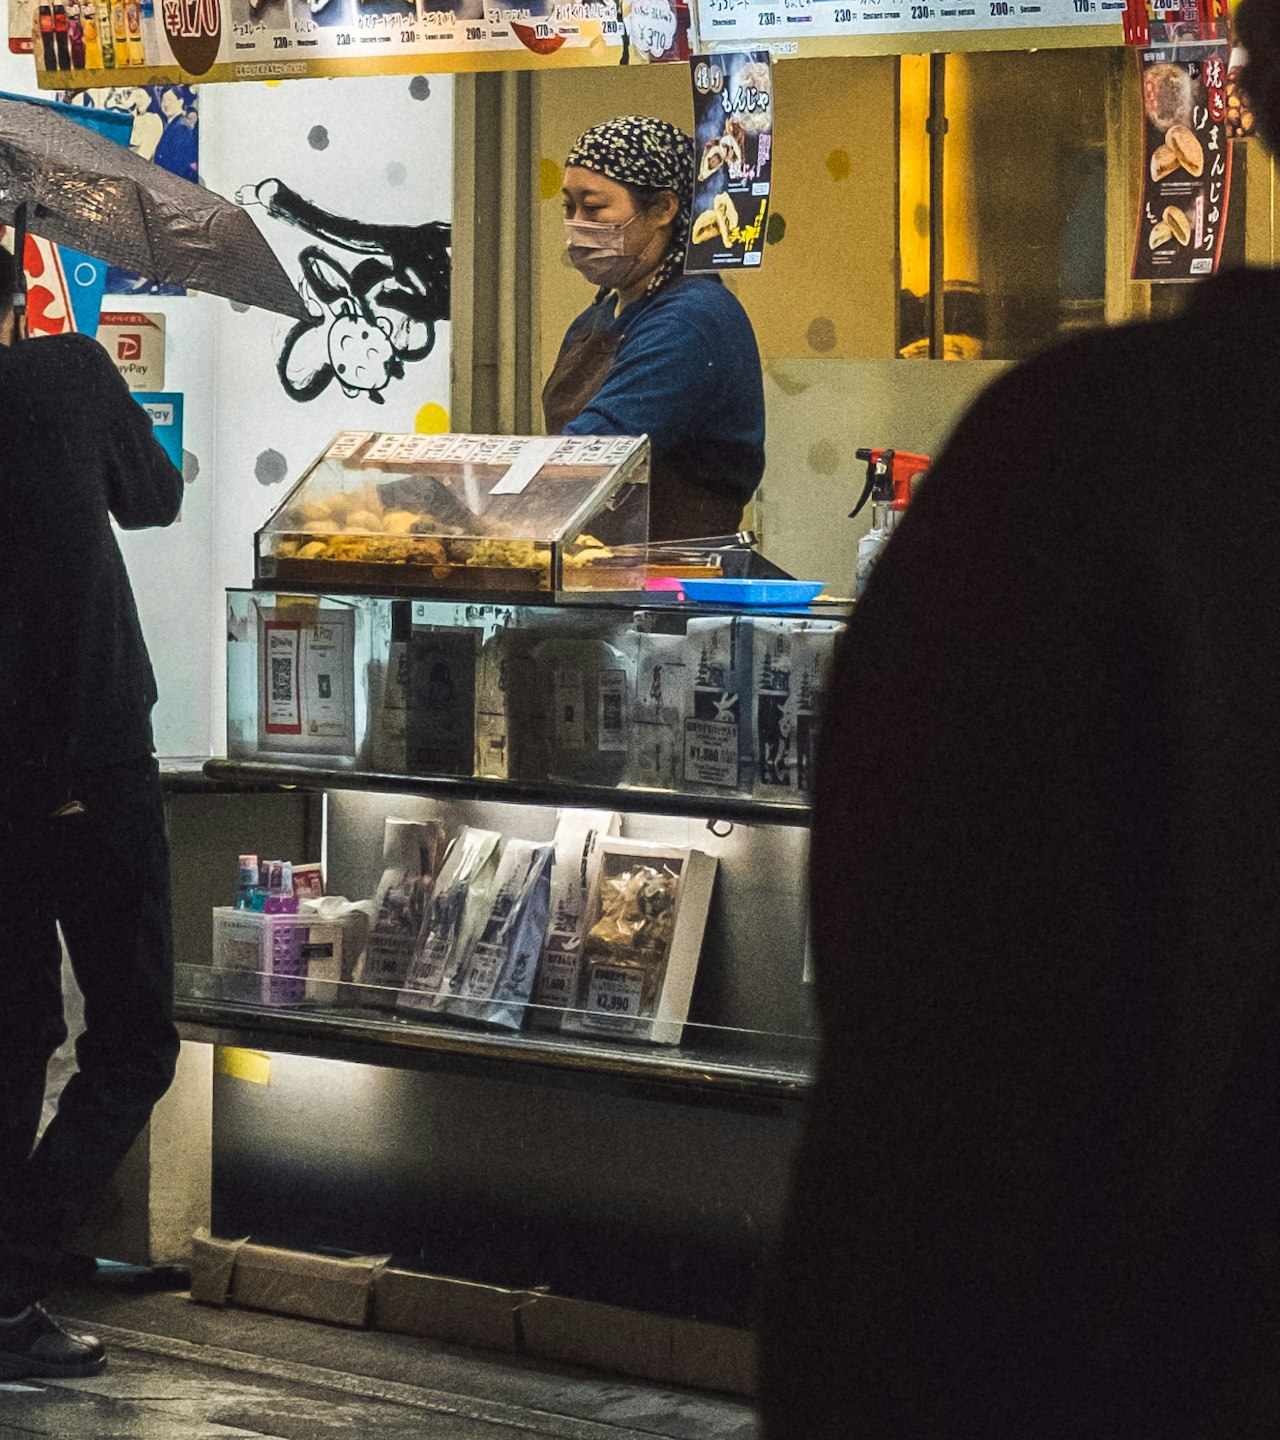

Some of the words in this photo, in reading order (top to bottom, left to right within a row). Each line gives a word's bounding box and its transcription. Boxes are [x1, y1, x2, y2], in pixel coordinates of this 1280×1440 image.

[721, 87, 769, 113] もんじゃ
[118, 364, 148, 375] ayPay
